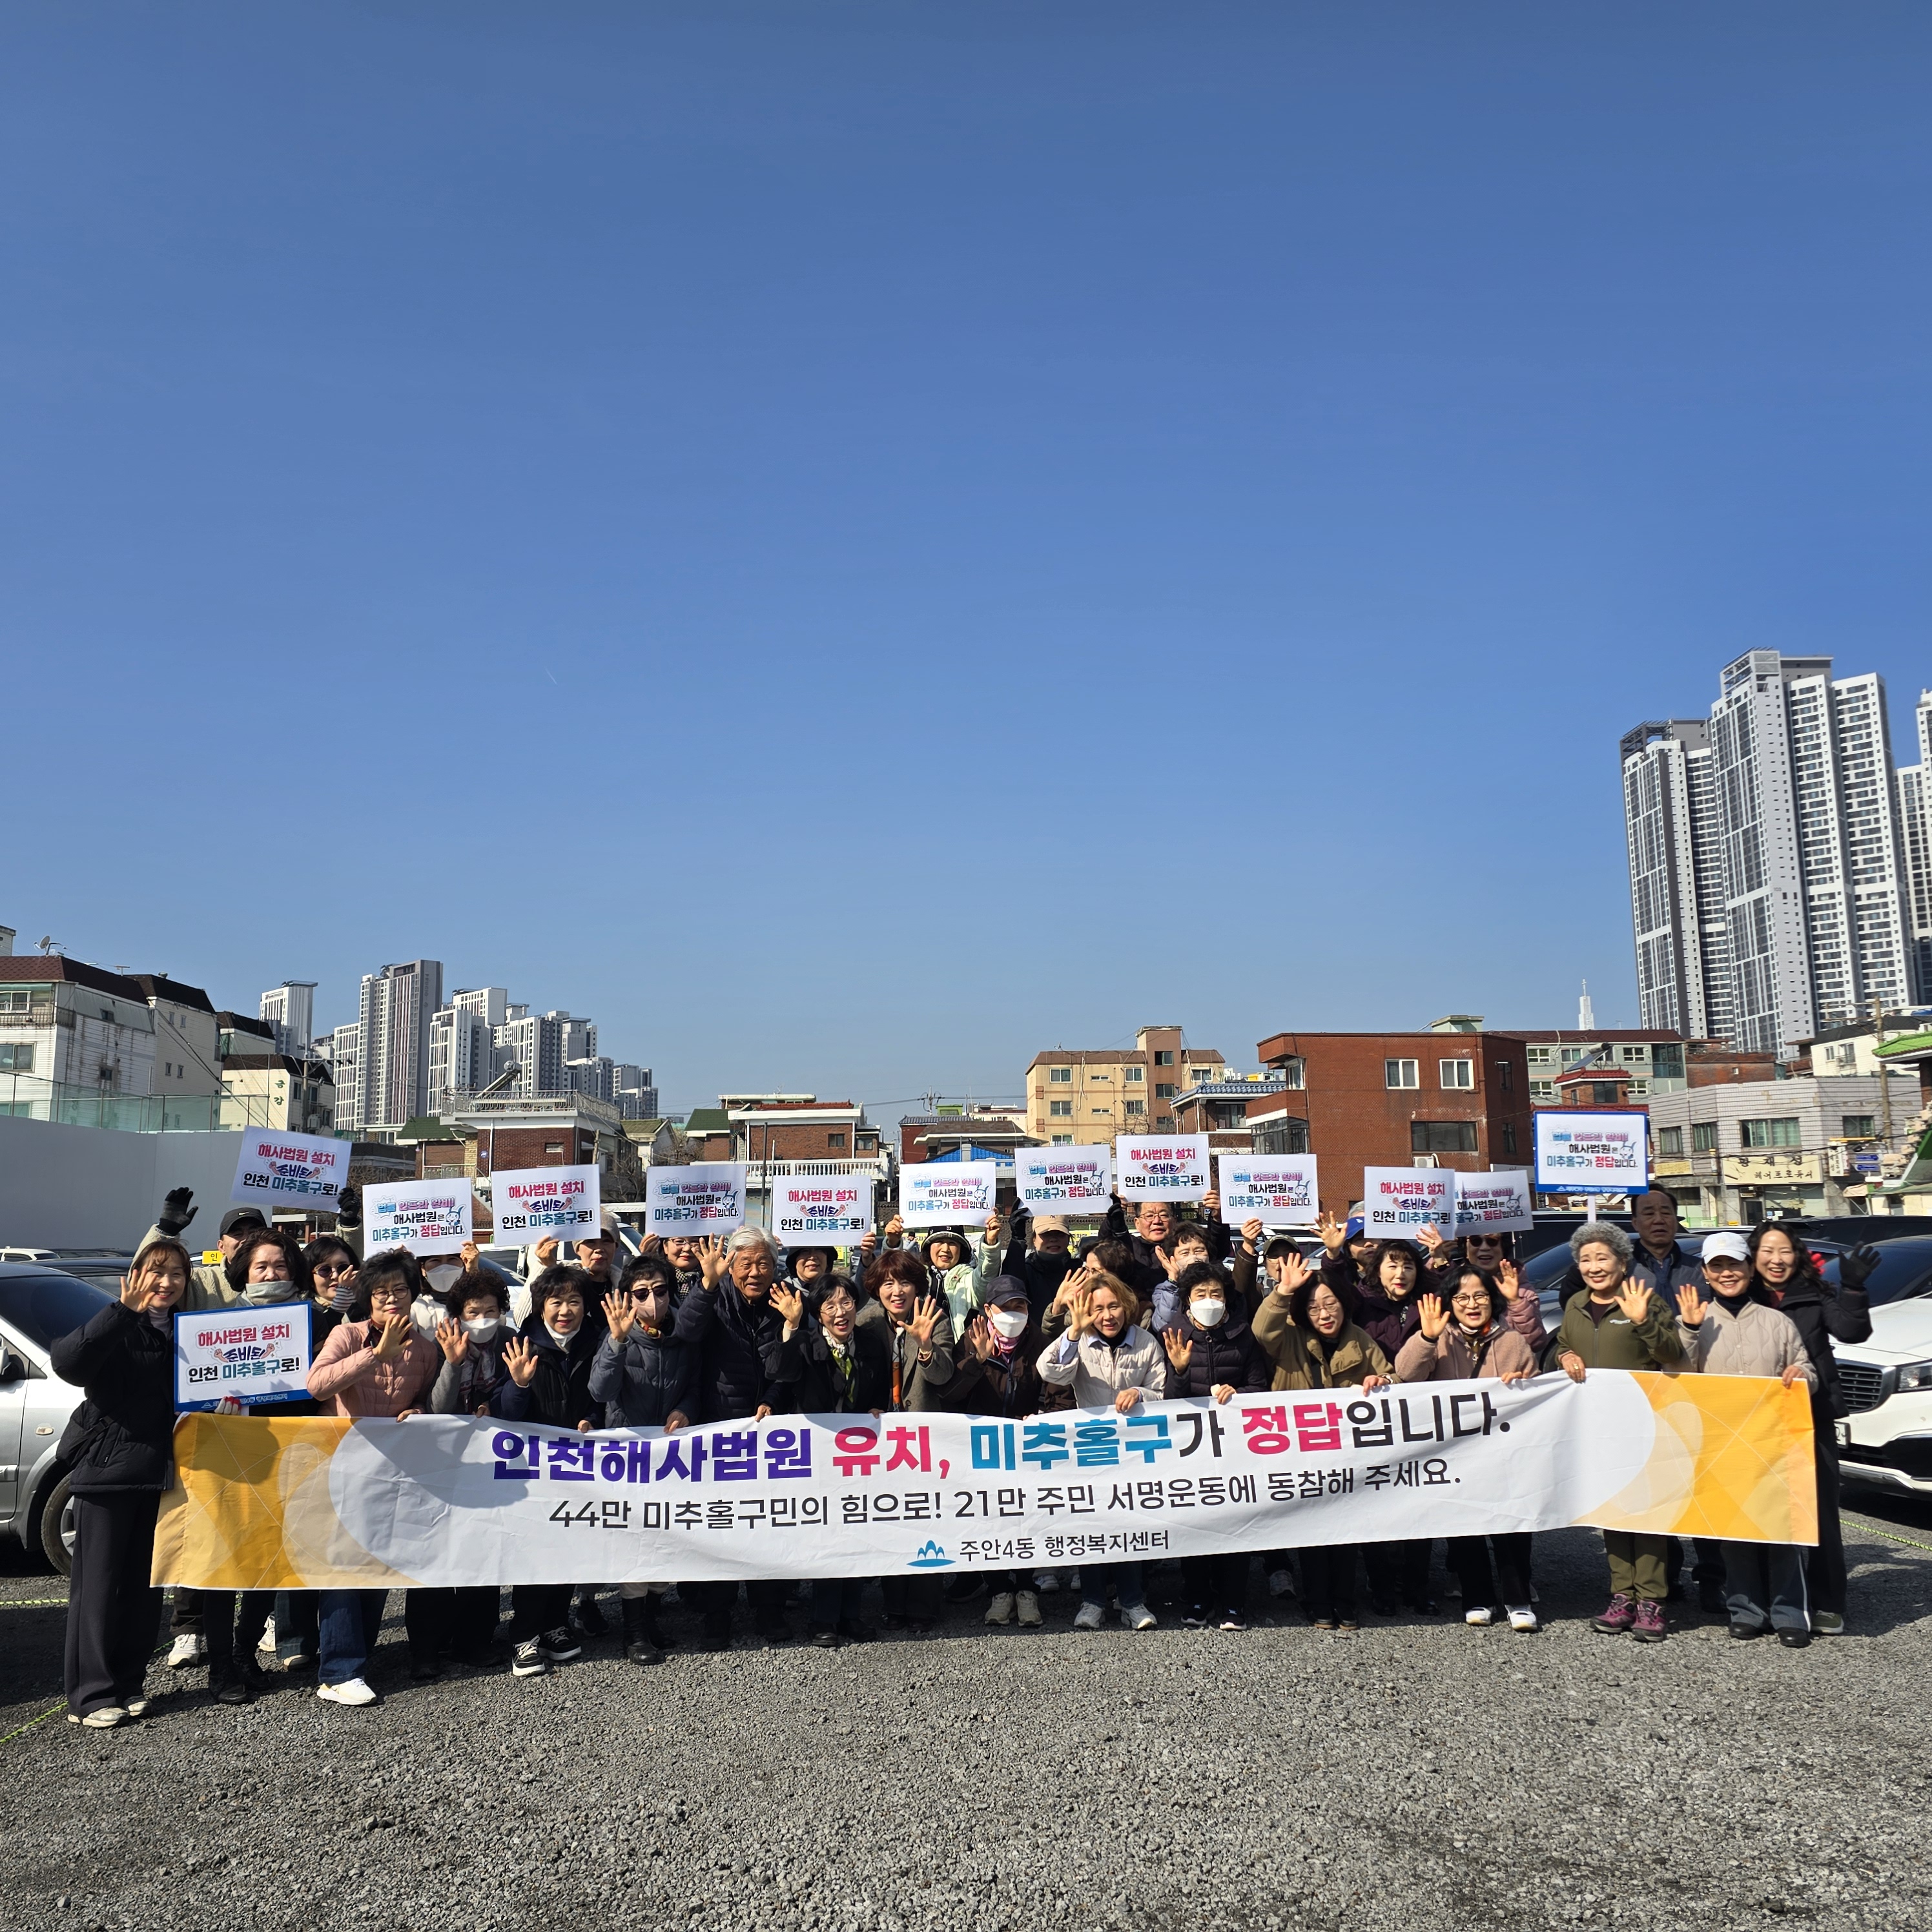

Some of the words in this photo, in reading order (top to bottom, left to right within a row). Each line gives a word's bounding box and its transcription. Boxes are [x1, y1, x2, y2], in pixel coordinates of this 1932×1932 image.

[274, 1080, 285, 1105] 금강
[258, 1144, 309, 1162] 해사법원
[311, 1151, 336, 1166] 설치
[1131, 1149, 1173, 1160] 해사법원
[1175, 1148, 1196, 1159] 설치
[1569, 1144, 1618, 1154] 해사법원은
[1547, 1156, 1592, 1167] 미추홀구가
[1595, 1156, 1638, 1167] 정답입니다.
[243, 1173, 270, 1188] 인천
[272, 1177, 338, 1196] 미추홀구로!
[1045, 1175, 1089, 1186] 해사법원은
[1125, 1177, 1146, 1187] 인천
[1149, 1175, 1204, 1187] 미추홀구로!
[508, 1182, 557, 1198] 해사법원
[560, 1180, 584, 1195] 설치
[929, 1188, 972, 1198] 해사법원은
[1025, 1187, 1066, 1200] 미추홀구가
[1068, 1186, 1107, 1197] 정답입니다.
[1249, 1184, 1294, 1193] 해사법원은
[1381, 1182, 1424, 1195] 해사법원
[1427, 1182, 1445, 1195] 설치
[676, 1195, 721, 1206] 해사법원은
[788, 1189, 832, 1202] 해사법원
[836, 1189, 857, 1201] 설치
[1229, 1196, 1271, 1208] 미추홀구가
[1273, 1195, 1311, 1207] 정답입니다.
[909, 1200, 949, 1211] 미추홀구가
[952, 1198, 990, 1210] 정답입니다.
[394, 1211, 445, 1225] 해사법원은
[502, 1215, 526, 1229] 인천
[529, 1210, 593, 1227] 미추홀구로!
[655, 1208, 697, 1220] 미추홀구가
[699, 1206, 739, 1218] 정답입니다.
[1373, 1211, 1395, 1223] 인천
[1399, 1211, 1450, 1224] 미추홀구로!
[1455, 1211, 1481, 1223] 홀구가
[781, 1218, 803, 1230] 인천
[807, 1218, 864, 1230] 미추홀구로!
[373, 1226, 418, 1242] 미추홀구가
[420, 1224, 465, 1237] 정답입니다.
[198, 1328, 257, 1346] 해사법원
[261, 1324, 289, 1341] 설치
[189, 1366, 218, 1383] 인천
[222, 1357, 300, 1379] 미추홀구로!
[492, 1428, 812, 1484] 인천해사법원
[832, 1425, 951, 1480] 유치,
[970, 1410, 1225, 1471] 미추홀구가
[1241, 1392, 1510, 1455] 정답입니다.
[549, 1499, 632, 1529] 44만
[643, 1495, 828, 1530] 미추홀구민의
[840, 1492, 941, 1524] 힘으로!
[953, 1487, 1027, 1519] 21만
[1036, 1485, 1096, 1517] 주민
[1107, 1474, 1257, 1512] 서명운동에
[1267, 1467, 1354, 1501] 동참해
[1364, 1457, 1462, 1492] 주세요.
[959, 1537, 1035, 1563] 주안4동
[1044, 1530, 1170, 1557] 행정복지센터
